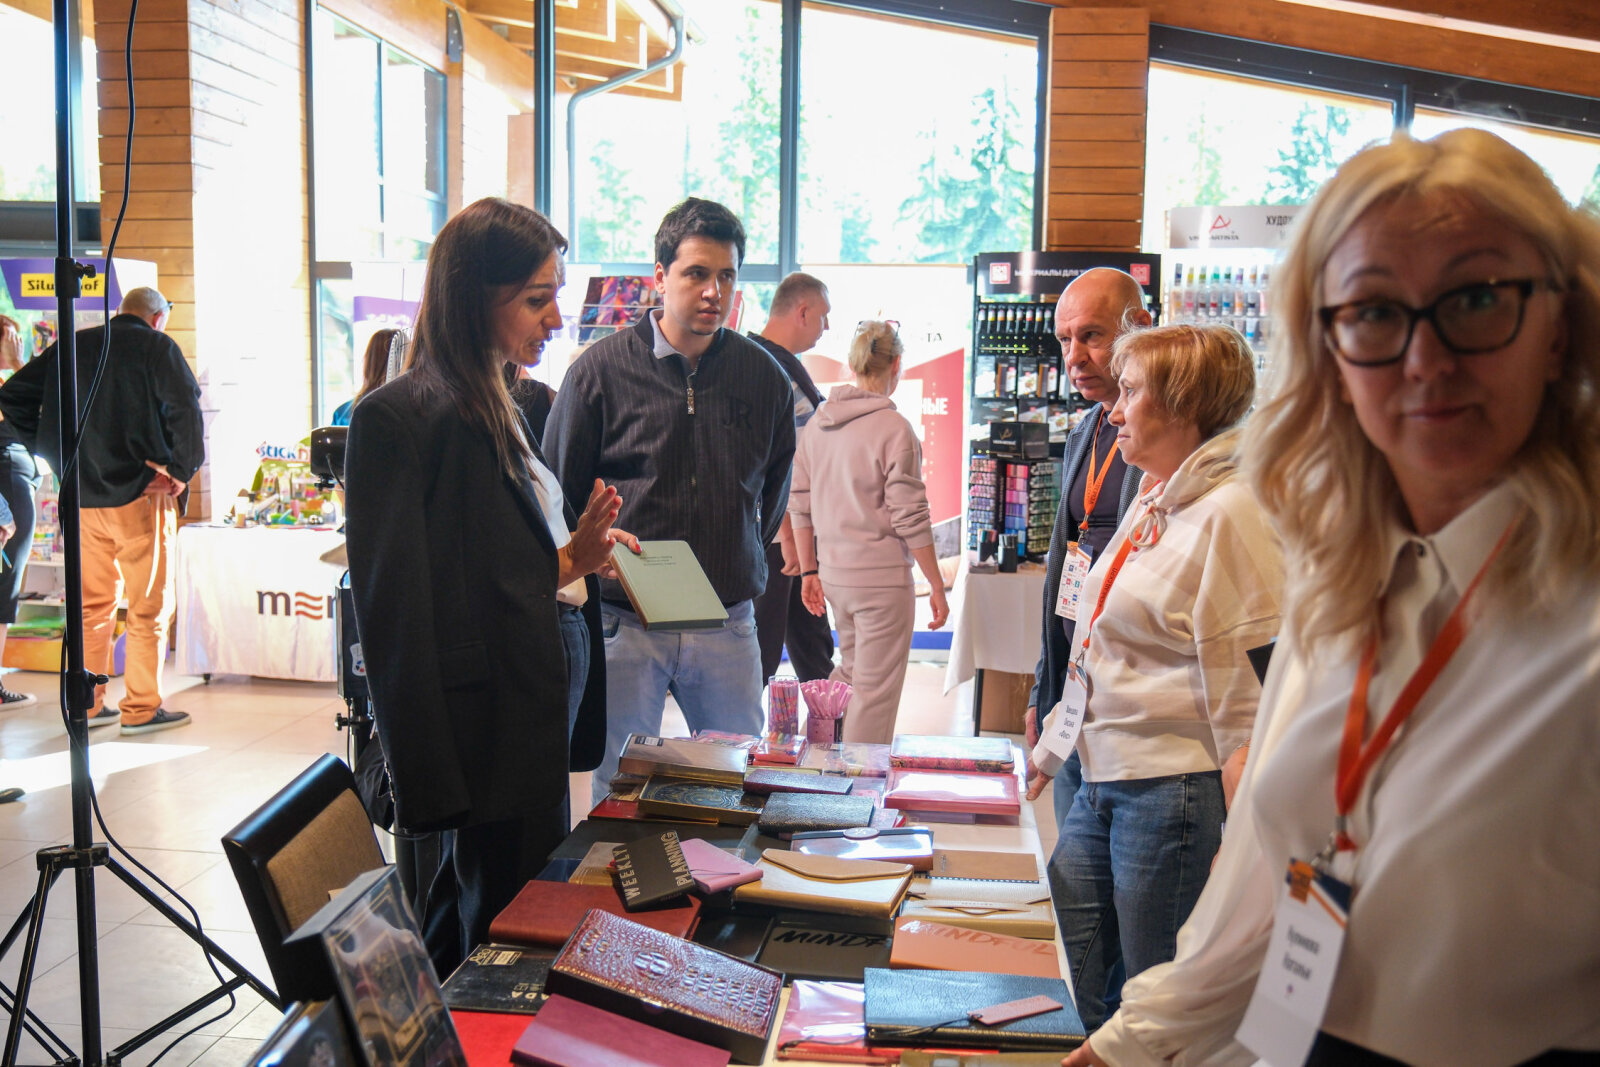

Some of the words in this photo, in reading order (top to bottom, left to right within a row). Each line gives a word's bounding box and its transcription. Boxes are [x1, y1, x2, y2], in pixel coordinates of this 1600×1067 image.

[612, 848, 641, 901] WEEKLY
[661, 830, 695, 888] PLANNING
[900, 920, 1055, 956] MINDFUL
